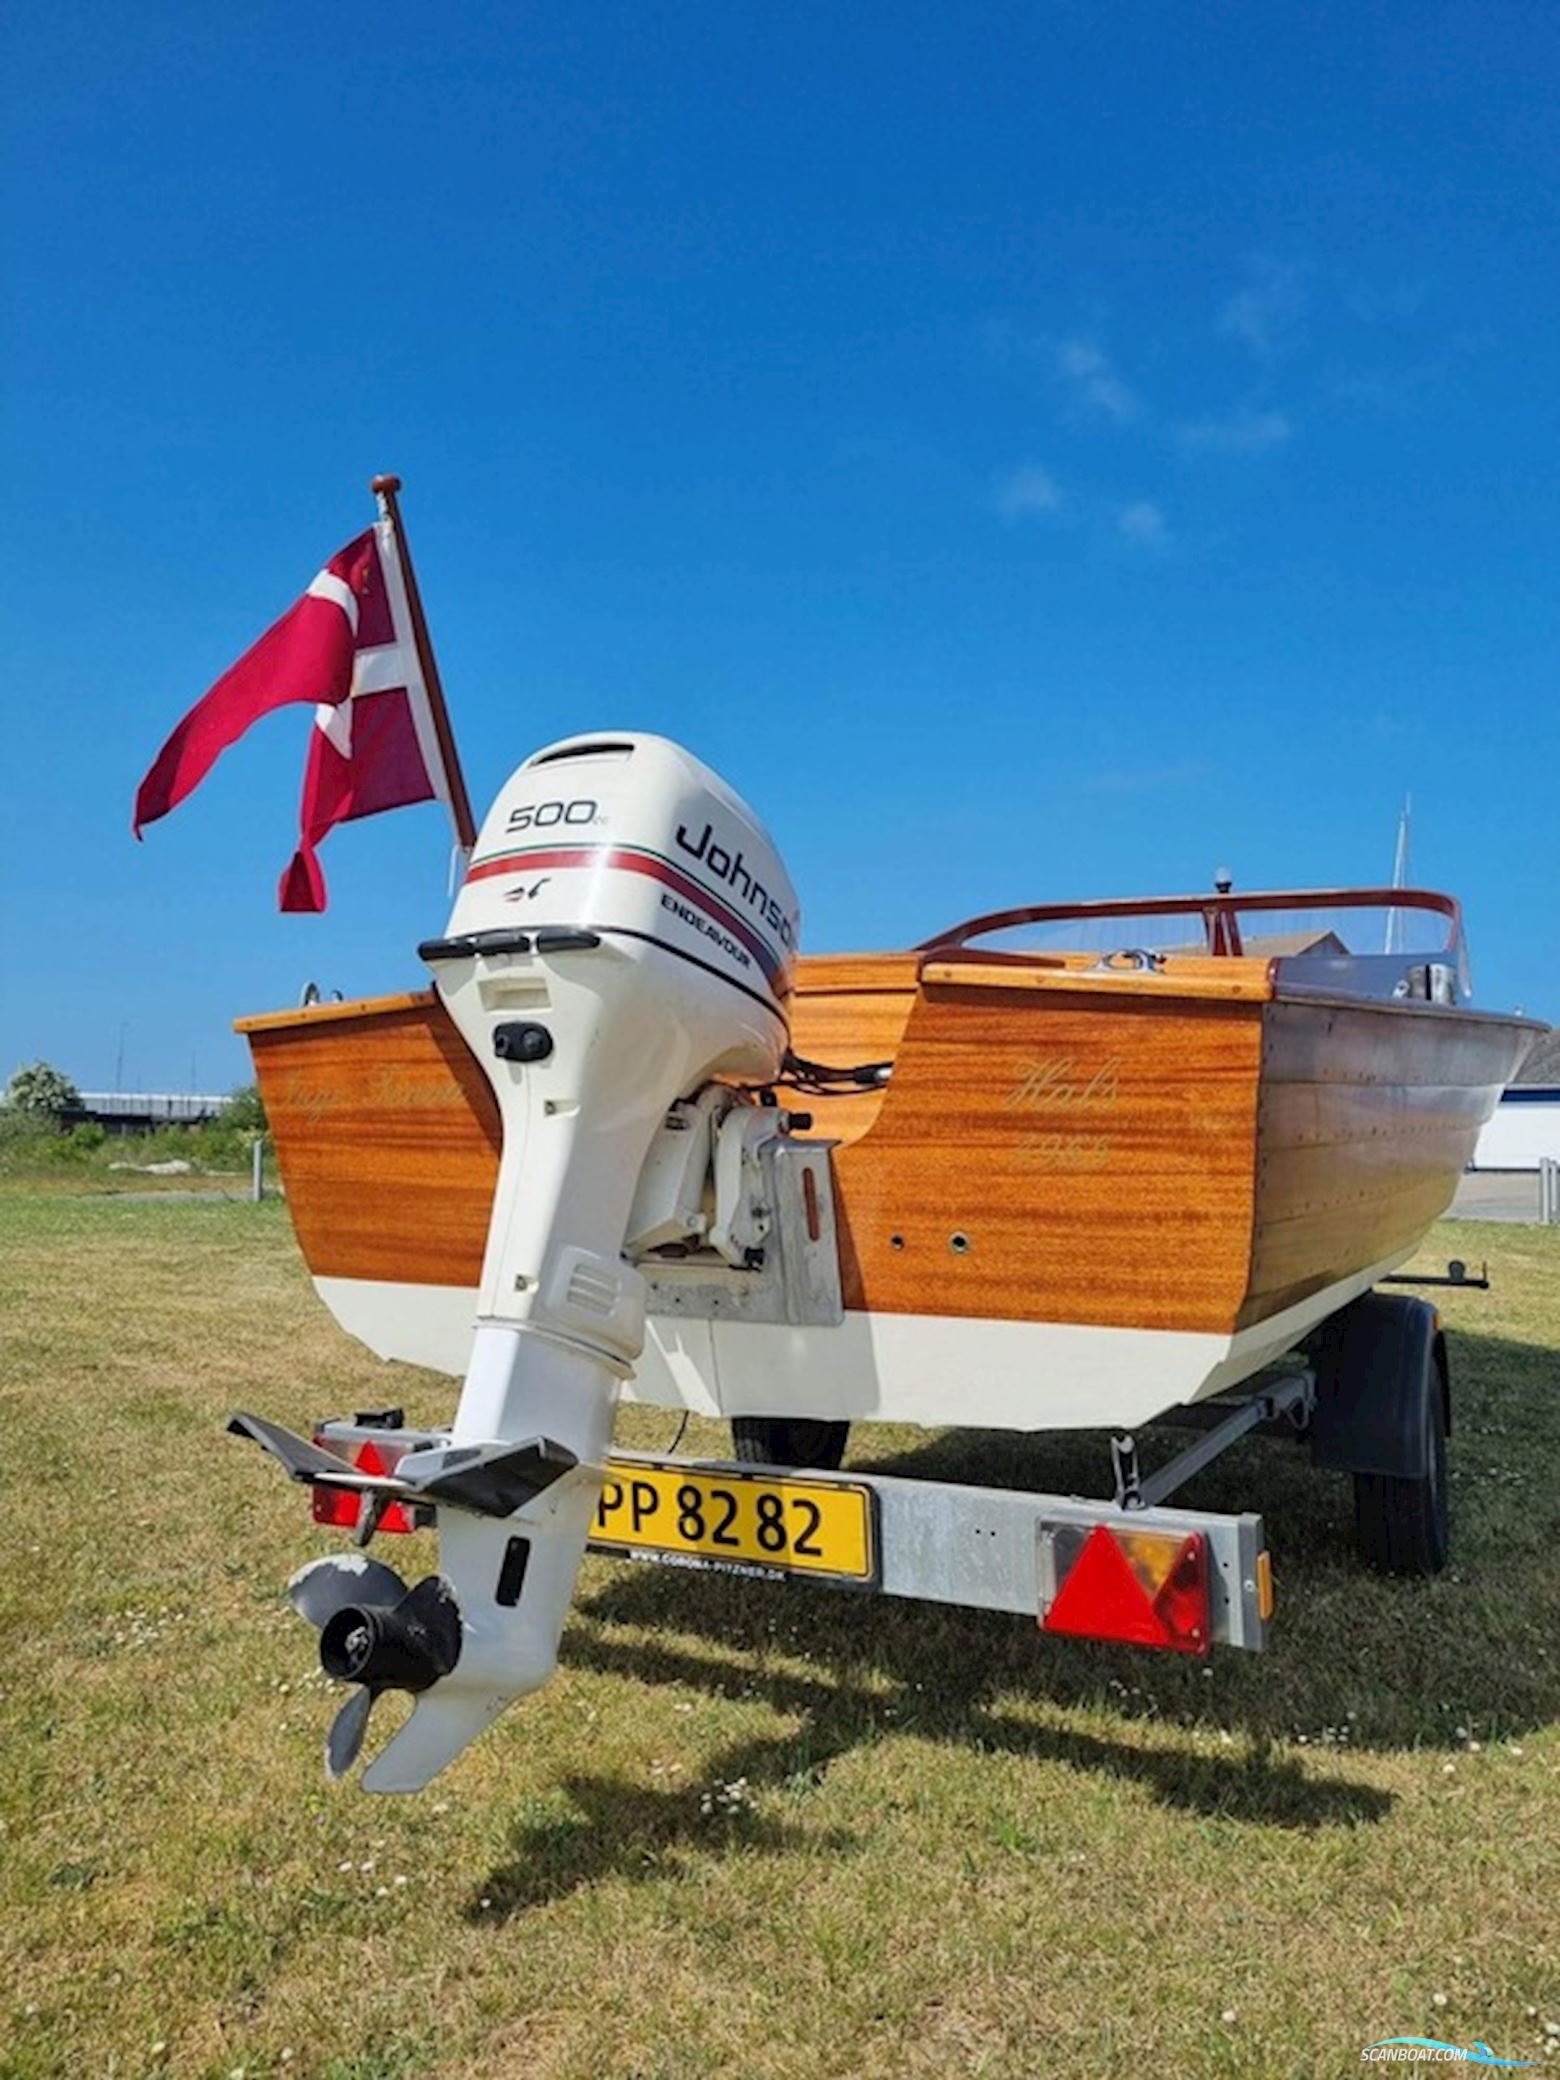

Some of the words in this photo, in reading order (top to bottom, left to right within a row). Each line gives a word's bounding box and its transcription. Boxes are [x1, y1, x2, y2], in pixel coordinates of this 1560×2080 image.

[505, 800, 598, 834] 500
[676, 824, 797, 950] Johnso
[661, 893, 750, 968] ENDEAVOUR
[598, 1480, 660, 1533] PP
[675, 1485, 740, 1547] 82
[756, 1493, 823, 1557] 82
